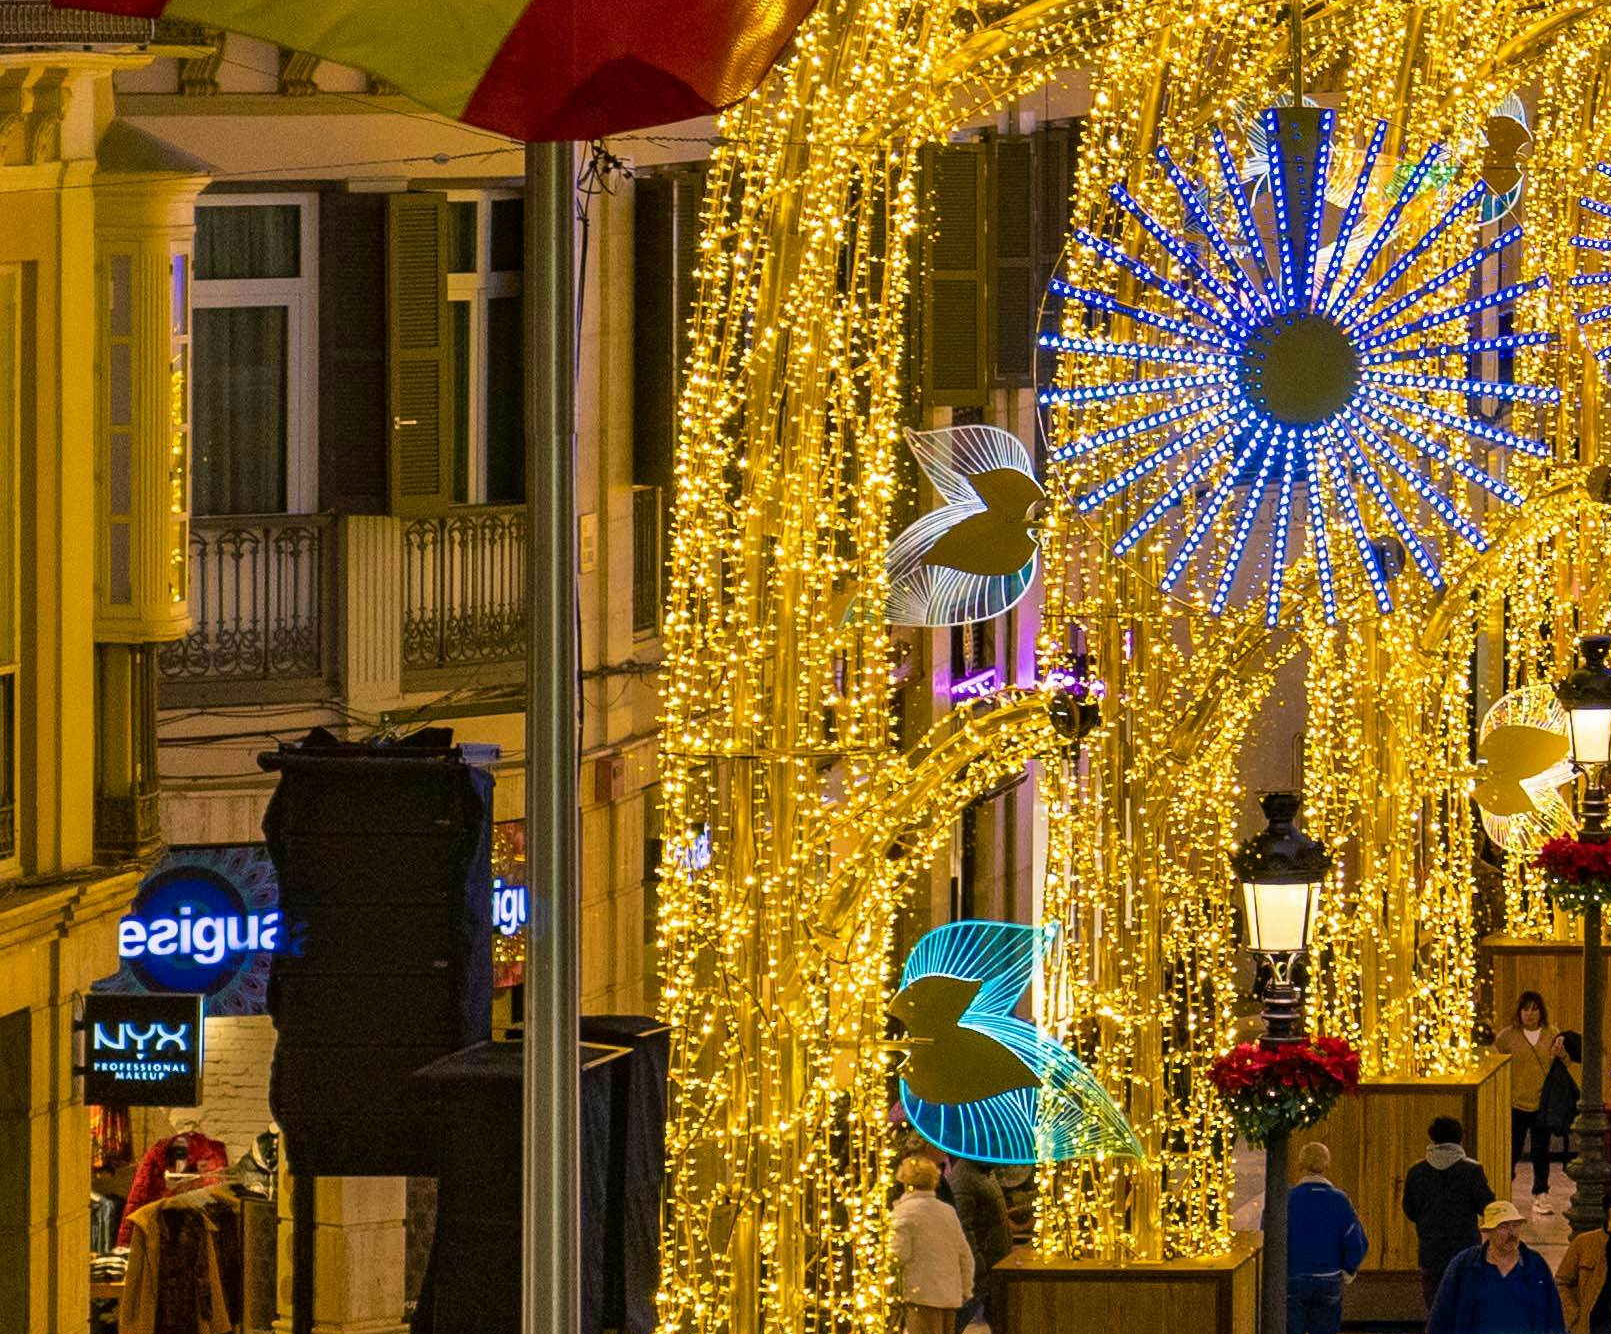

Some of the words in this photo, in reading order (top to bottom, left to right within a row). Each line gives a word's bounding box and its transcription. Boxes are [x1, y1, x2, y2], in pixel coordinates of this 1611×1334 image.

[93, 1023, 188, 1051] NYX
[93, 1062, 187, 1073] PROFESSIONAL
[114, 1072, 166, 1081] MAKEUP
